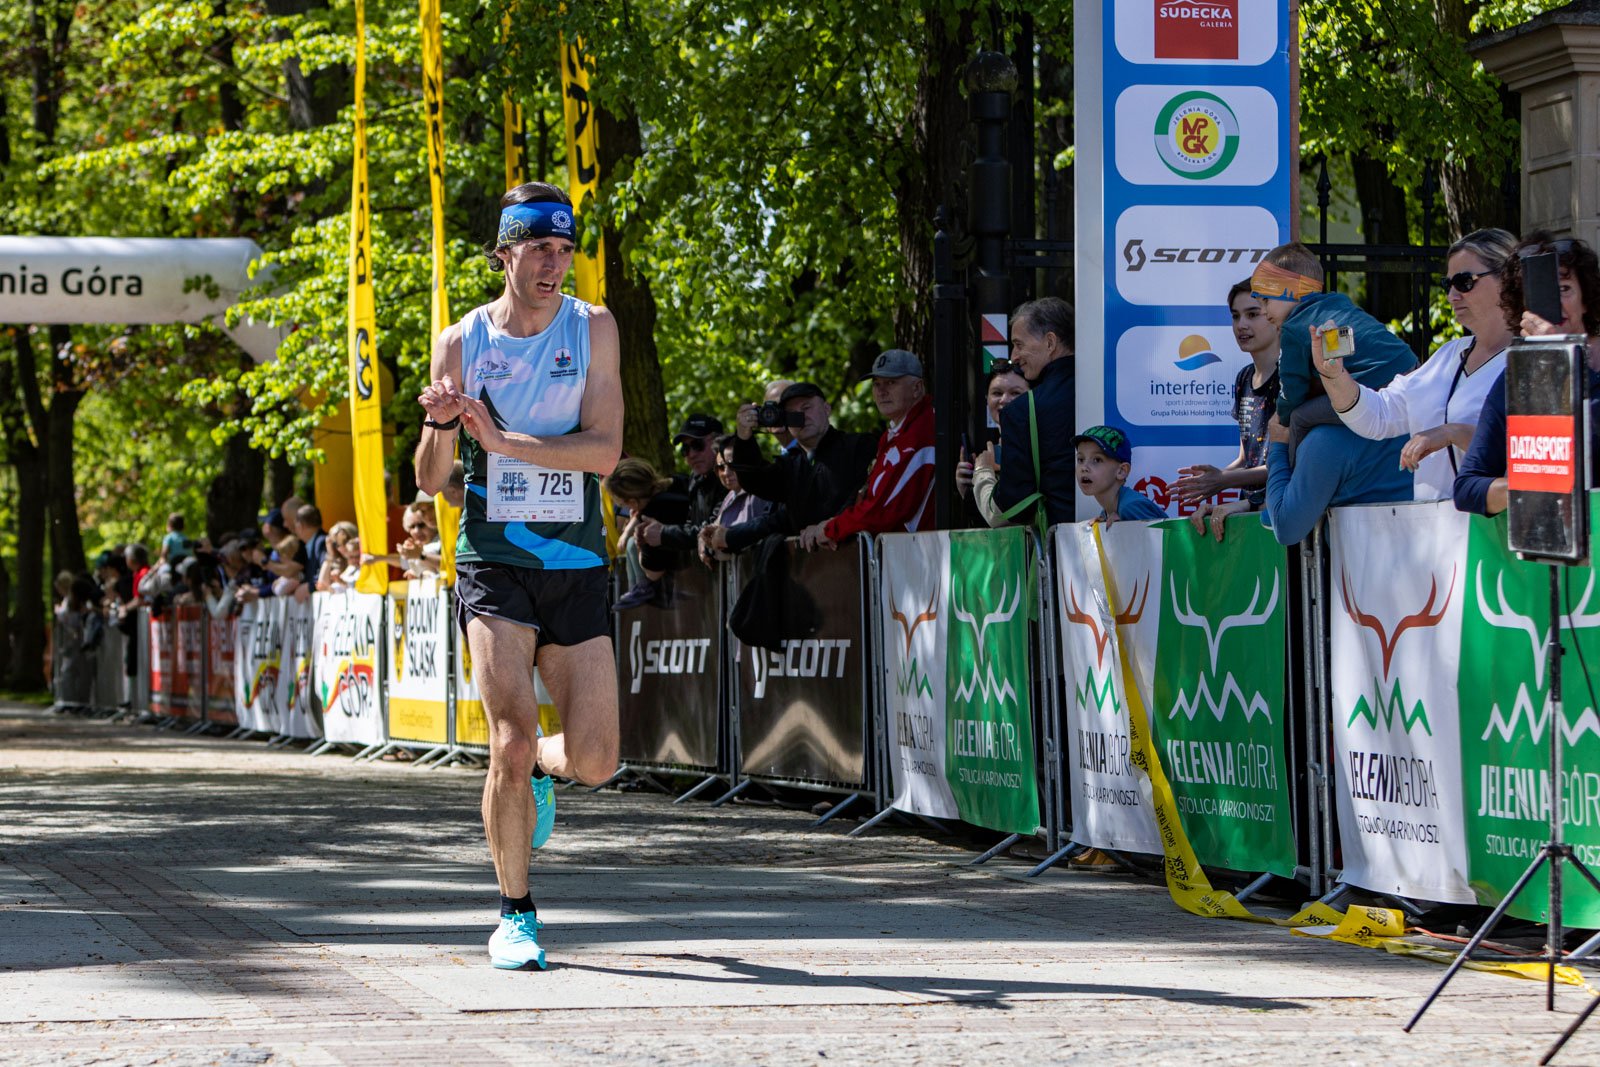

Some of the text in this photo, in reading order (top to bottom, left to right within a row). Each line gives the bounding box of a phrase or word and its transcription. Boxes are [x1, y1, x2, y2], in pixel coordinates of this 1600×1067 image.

[1160, 7, 1232, 19] SUDECKA
[1173, 107, 1221, 126] JELENIA GÓRA
[1150, 248, 1271, 263] SCOTT
[61, 265, 143, 296] Góra
[1510, 435, 1571, 461] DATASPORT
[538, 472, 573, 496] 725
[409, 598, 439, 634] DOLNY
[644, 638, 711, 674] SCOTT
[1167, 737, 1278, 791] JELENIA GÓRA
[1478, 764, 1600, 827] JELENIA GÓR
[1178, 796, 1276, 822] STOLICA KARKONOSZY
[1486, 834, 1528, 858] STOLICA
